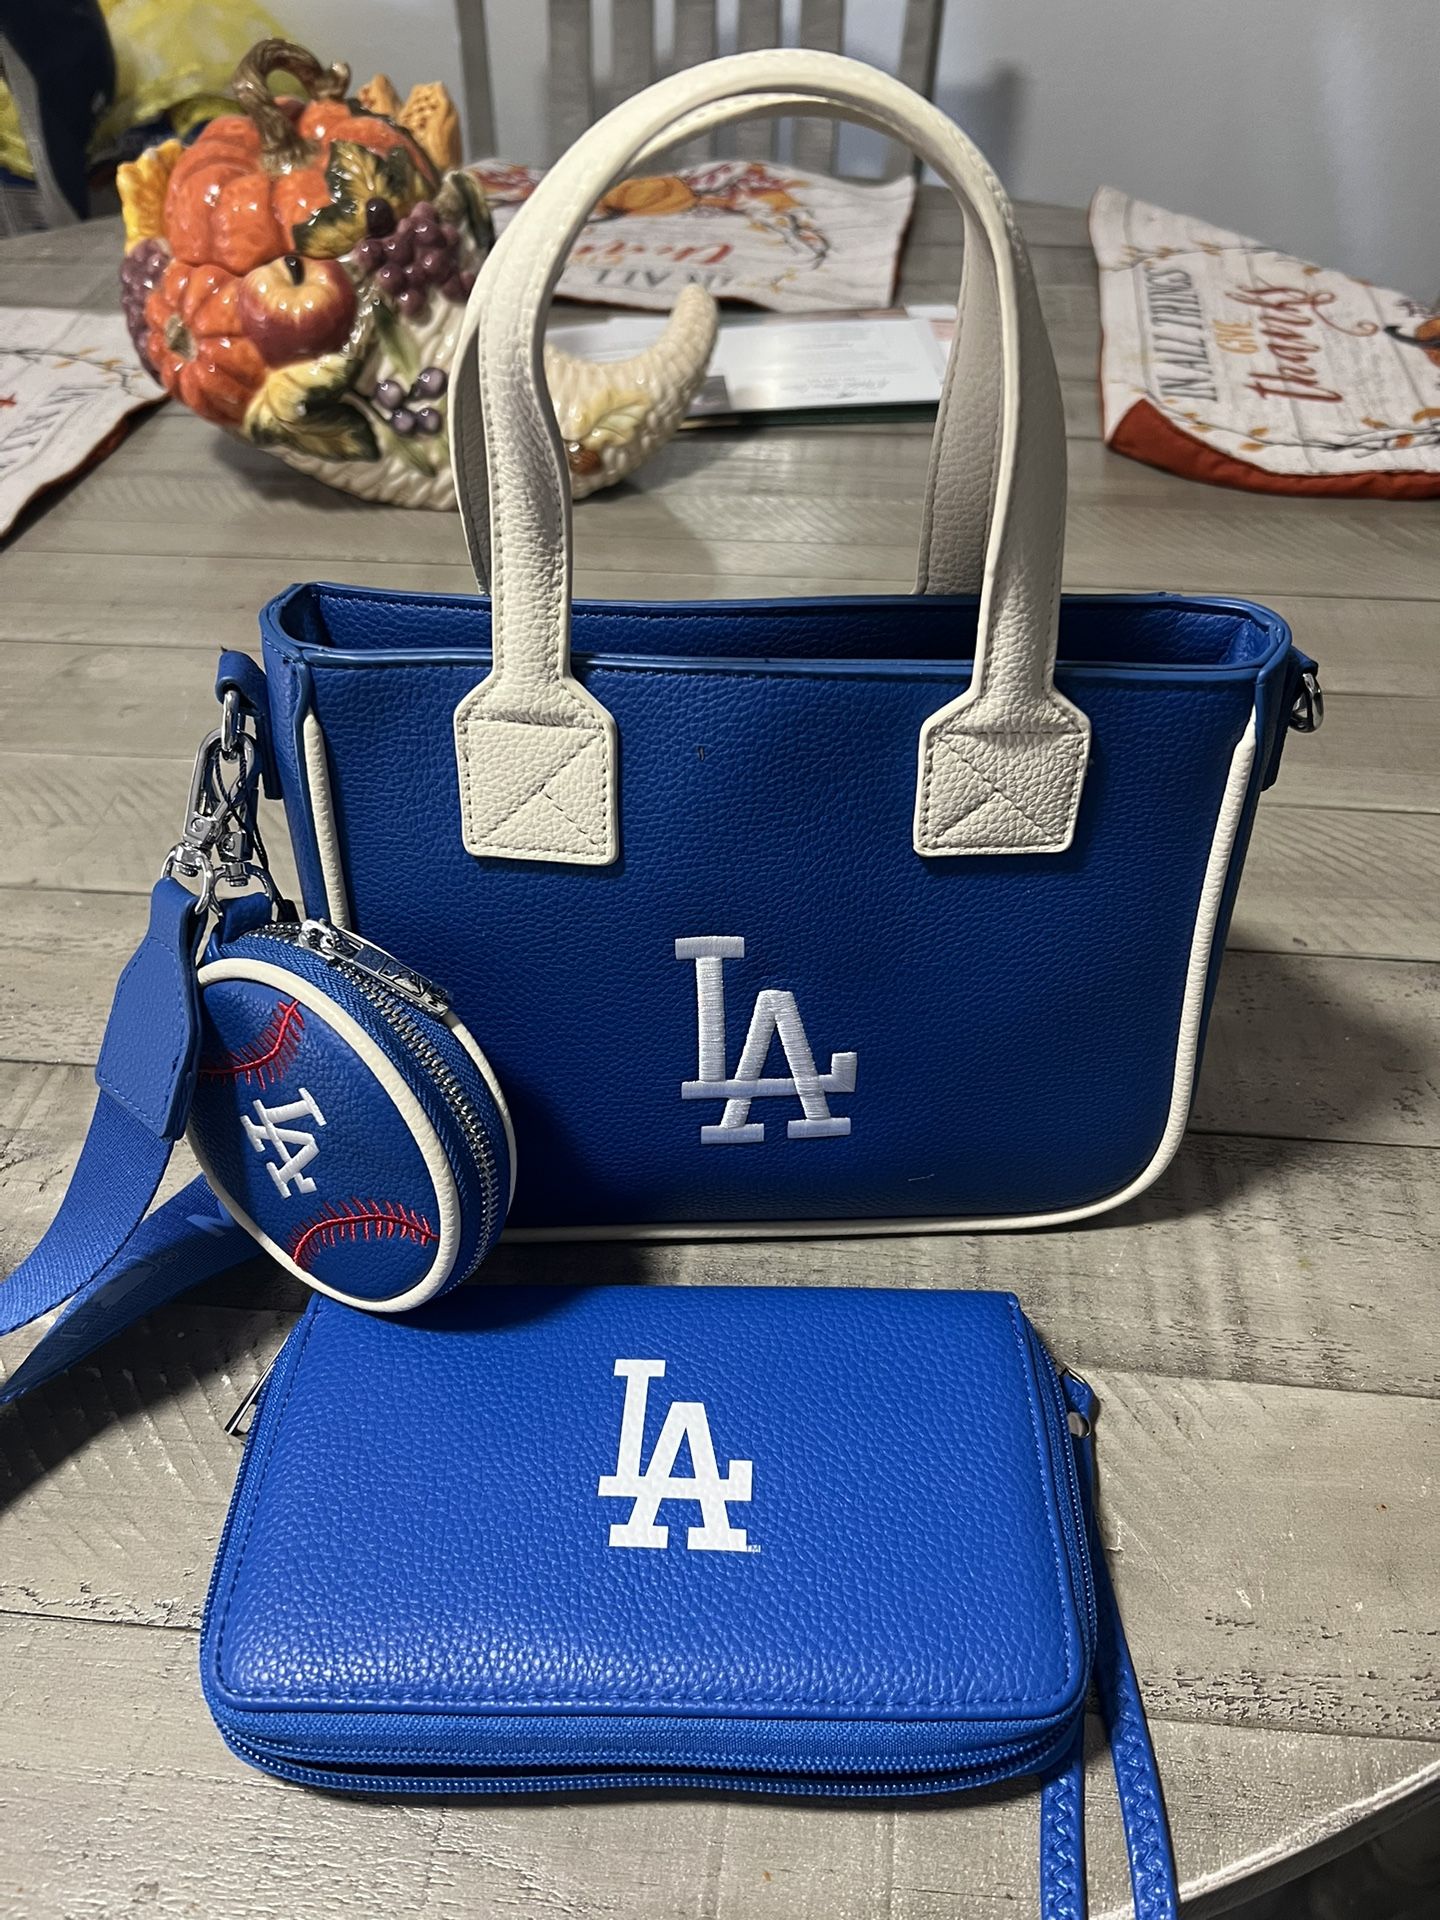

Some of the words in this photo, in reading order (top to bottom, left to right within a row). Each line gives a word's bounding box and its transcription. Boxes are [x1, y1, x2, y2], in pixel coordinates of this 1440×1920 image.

[1144, 268, 1203, 330] THINGS
[1212, 319, 1259, 355] GIVE
[1153, 333, 1214, 376] ALL
[1224, 284, 1345, 402] thanks
[1157, 375, 1217, 401] IN
[675, 936, 858, 1144] LA
[240, 1087, 327, 1199] LA
[598, 1359, 753, 1553] LA
